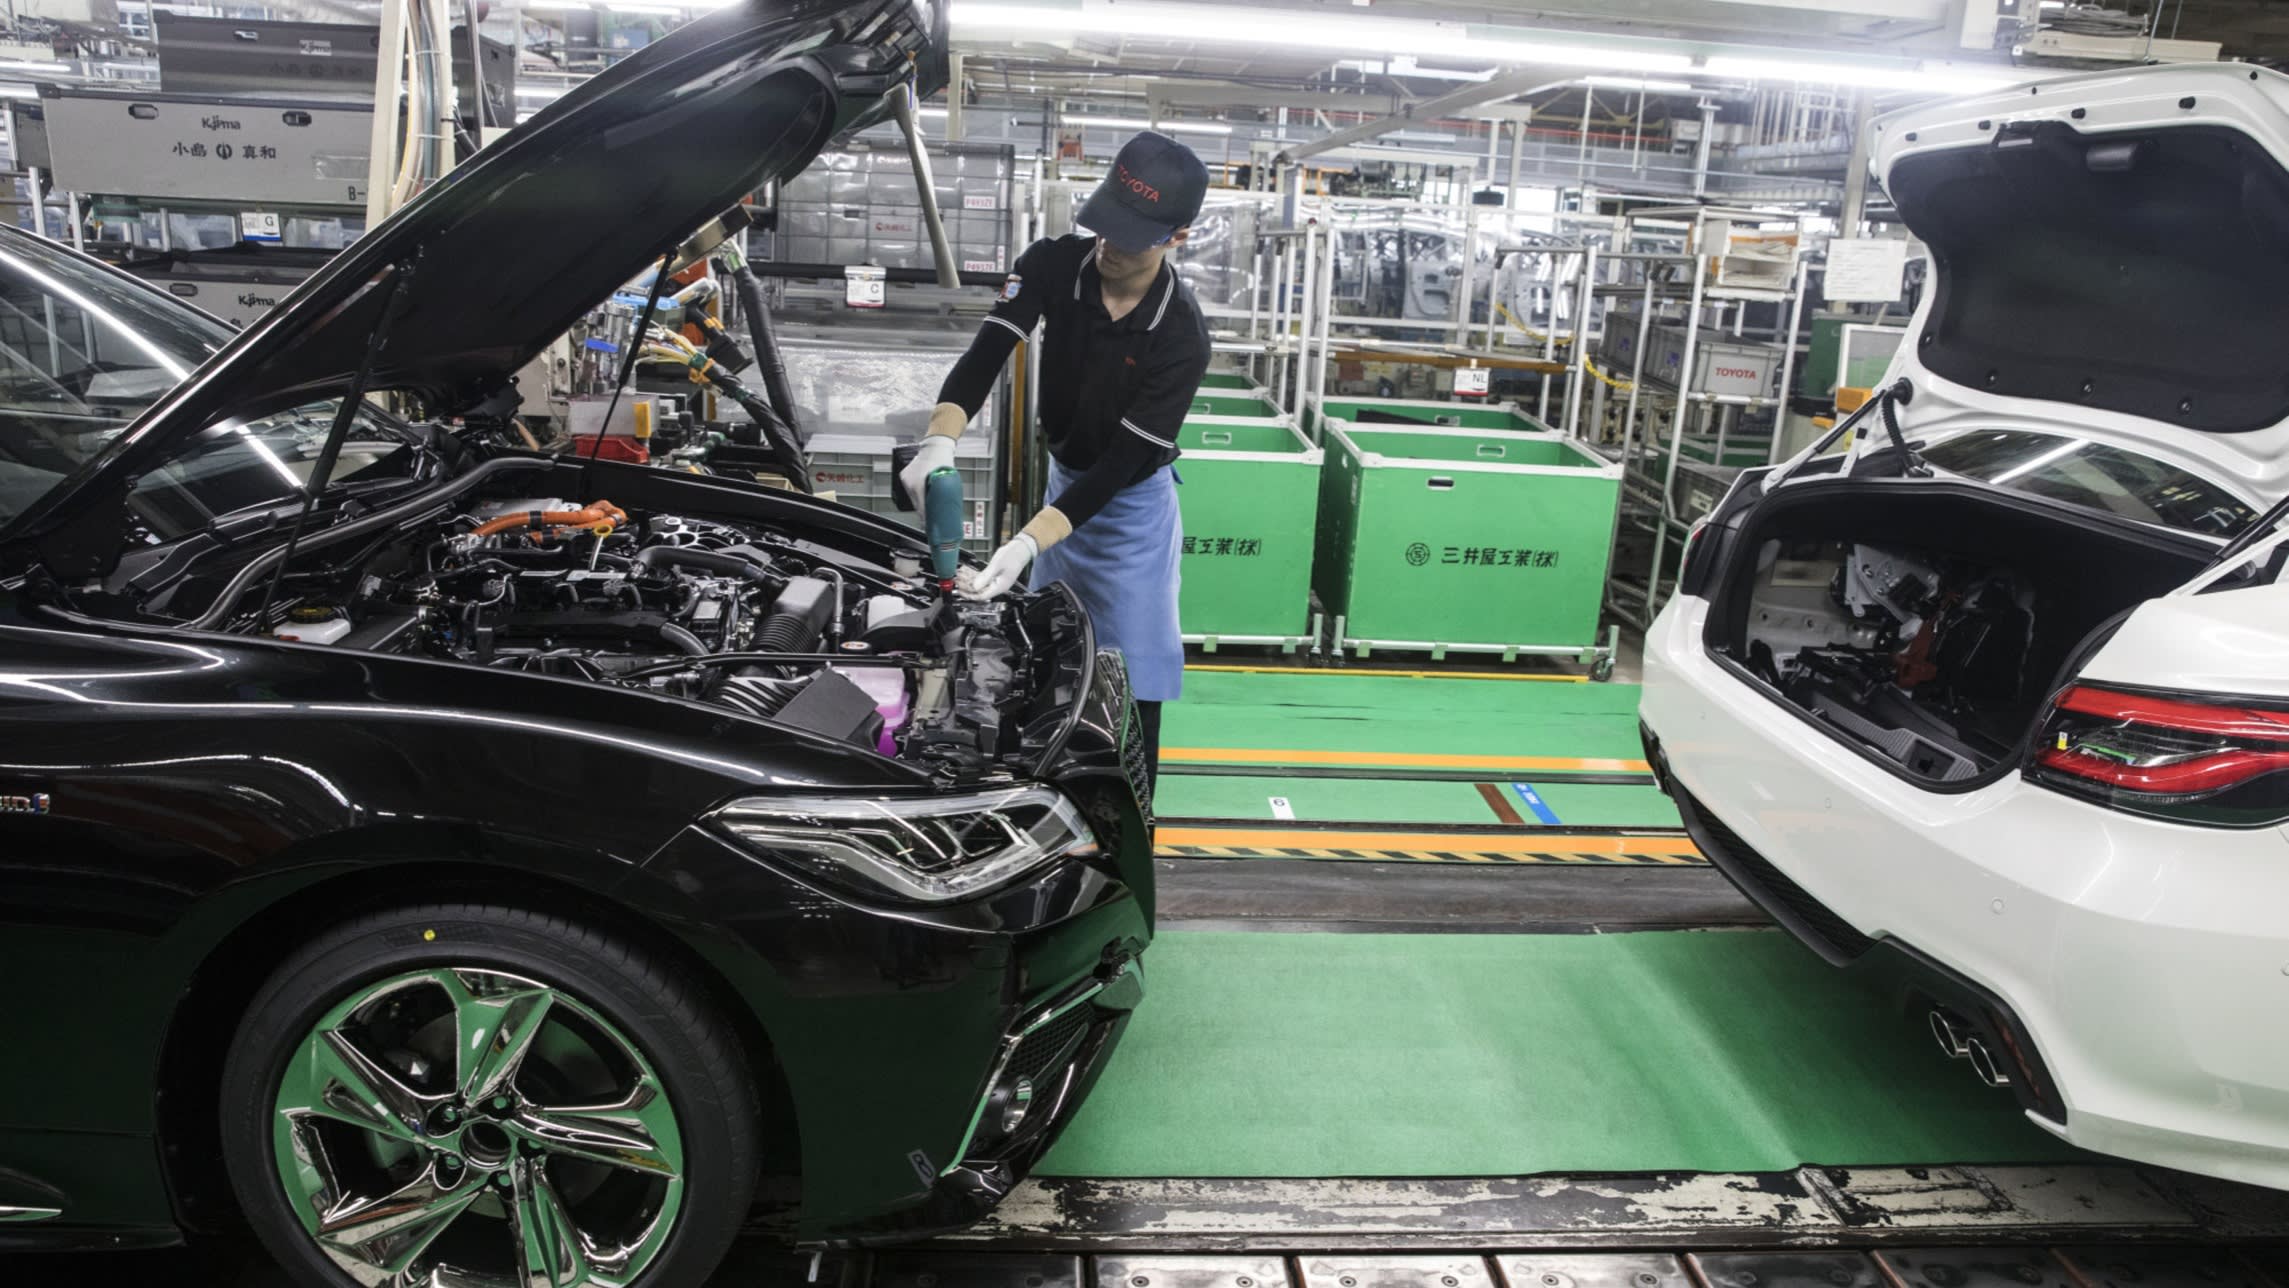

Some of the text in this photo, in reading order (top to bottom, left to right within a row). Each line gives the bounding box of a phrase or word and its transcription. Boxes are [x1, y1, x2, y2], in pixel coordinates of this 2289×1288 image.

[1119, 164, 1160, 203] TOYOTA
[264, 215, 274, 228] G
[1472, 373, 1488, 383] NL
[1715, 367, 1757, 380] TOYOTA
